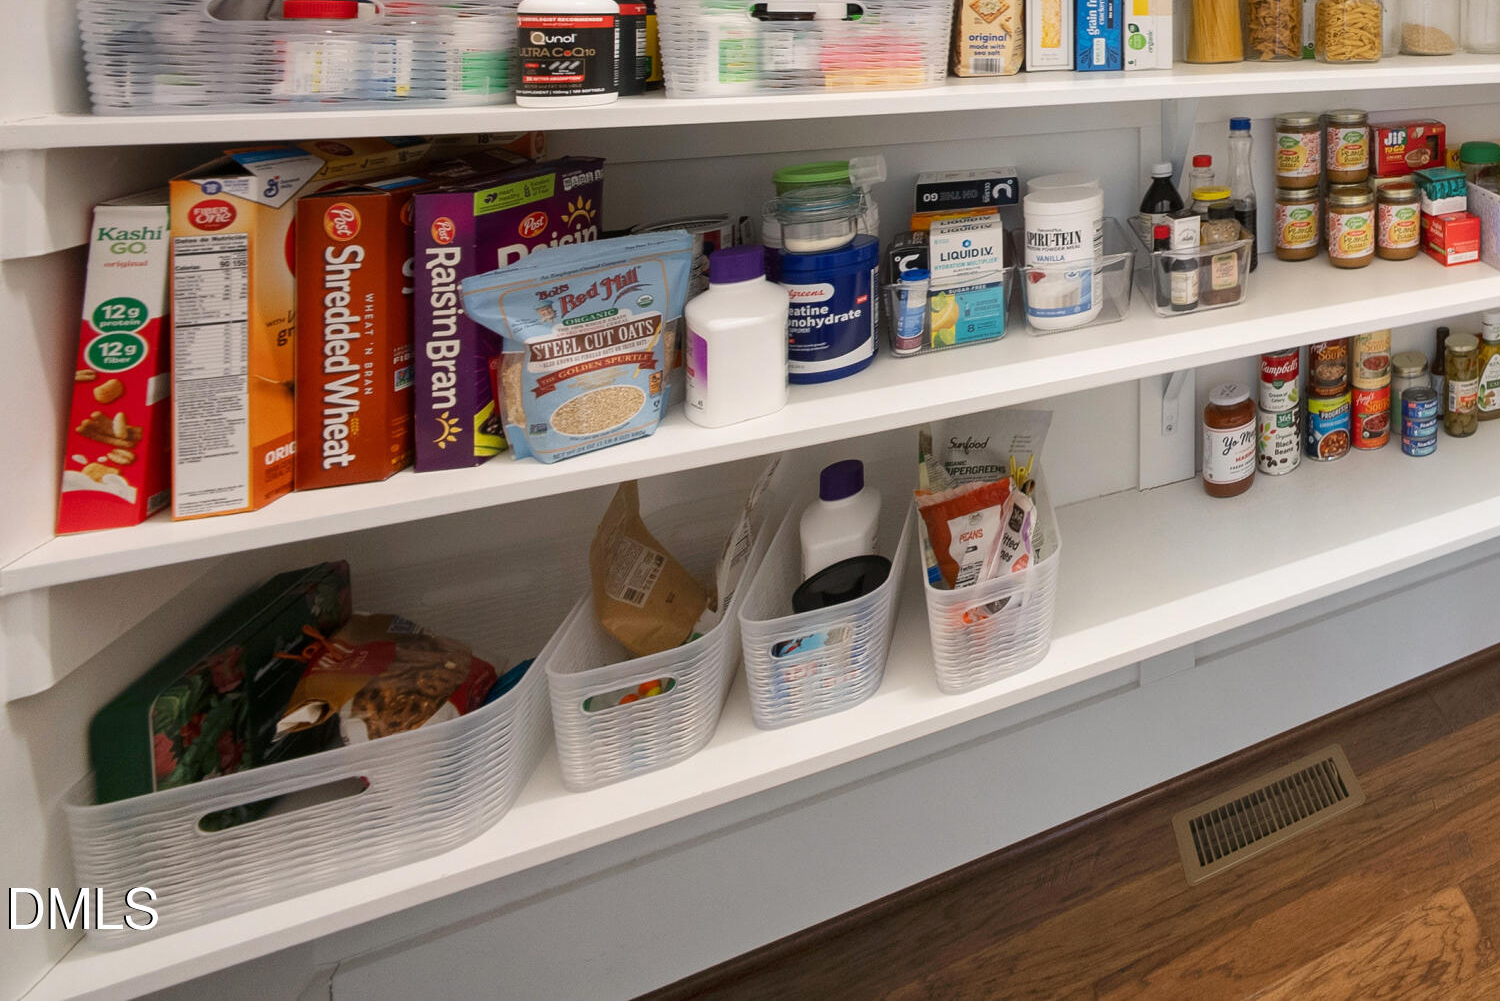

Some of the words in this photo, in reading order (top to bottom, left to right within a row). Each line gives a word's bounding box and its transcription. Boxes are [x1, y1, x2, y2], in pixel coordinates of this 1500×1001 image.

[1087, 9, 1101, 36] grain
[530, 30, 576, 45] Qunol
[968, 33, 1007, 44] original
[923, 192, 939, 203] GO
[193, 206, 229, 216] FIBER
[195, 212, 233, 224] One
[331, 207, 354, 237] Post
[524, 216, 545, 235] Post
[940, 216, 978, 226] LIQUID
[940, 224, 979, 234] LIQUID
[97, 226, 162, 241] Kashi
[435, 221, 452, 243] Post
[1026, 229, 1082, 247] SPIRU-TEIN
[110, 242, 147, 255] GO
[940, 248, 980, 262] LIQUID
[103, 260, 149, 269] original
[934, 261, 965, 271] HYDRATION
[425, 247, 462, 337] Raisin
[560, 282, 600, 318] Red
[601, 267, 639, 301] Mill
[322, 244, 365, 375] Shredded
[364, 292, 375, 336] WHEAT
[564, 308, 617, 325] ORGANIC
[789, 305, 829, 317] eatine
[100, 319, 141, 329] protein
[787, 309, 862, 329] nohydrate
[967, 324, 975, 333] 8
[531, 339, 582, 361] STEEL
[583, 330, 617, 353] CUT
[618, 319, 655, 341] OATS
[103, 356, 132, 364] fiber
[558, 358, 602, 378] GOLDEN
[603, 353, 652, 366] SPURTLE
[1260, 358, 1298, 376] Campbell's
[364, 361, 374, 396] BRAN
[425, 338, 461, 410] Bran
[1320, 403, 1350, 419] PROGRESSO
[322, 373, 361, 470] Wheat
[1277, 414, 1292, 425] 365
[947, 435, 992, 455] Sunfood
[1222, 436, 1239, 455] Yo
[1274, 447, 1294, 456] Beans
[1275, 440, 1294, 449] Black
[959, 529, 984, 543] PECANS
[1002, 532, 1020, 550] itted
